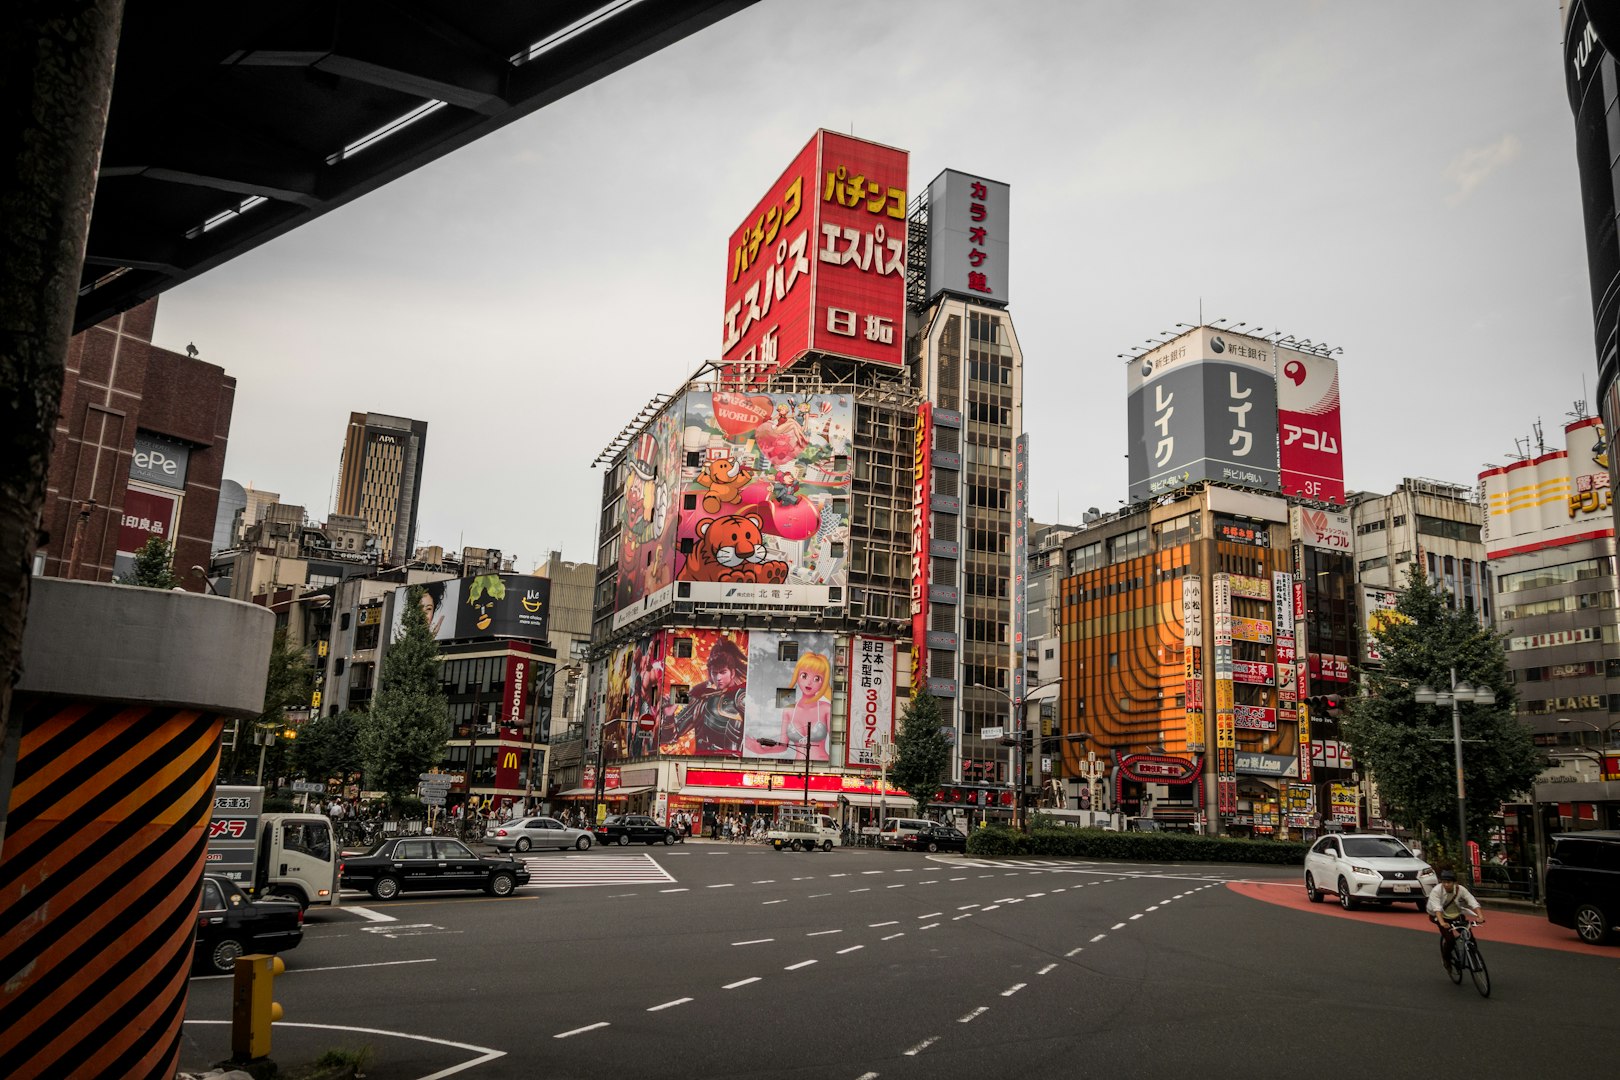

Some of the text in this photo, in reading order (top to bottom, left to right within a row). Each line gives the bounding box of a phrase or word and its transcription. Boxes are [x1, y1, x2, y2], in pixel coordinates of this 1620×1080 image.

[823, 164, 907, 220] パチンコ
[732, 175, 803, 283] パチンコ
[968, 181, 993, 293] カラオケ館
[819, 222, 904, 278] エスパス
[723, 229, 809, 354] エスパス
[827, 305, 893, 344] 日拓
[1155, 346, 1186, 369] 新生銀行
[1227, 343, 1267, 362] 新生銀行
[718, 408, 759, 424] WORLD
[1154, 384, 1174, 468] レイク
[1228, 371, 1253, 457] レイク
[377, 434, 395, 444] APA
[915, 412, 925, 480] パチンコ
[1283, 423, 1338, 455] アコム
[1304, 480, 1322, 496] 3F
[911, 484, 924, 578] エスパス
[1315, 532, 1349, 548] アイフル
[758, 589, 793, 599] 北電子
[1192, 587, 1200, 636] 小松ビル
[861, 641, 873, 688] 超大型店
[873, 642, 884, 685] 日本一の
[1248, 663, 1268, 676] 本陣
[1321, 659, 1347, 671] アイフル
[1545, 695, 1600, 711] FLARE
[209, 820, 247, 837] メラ
